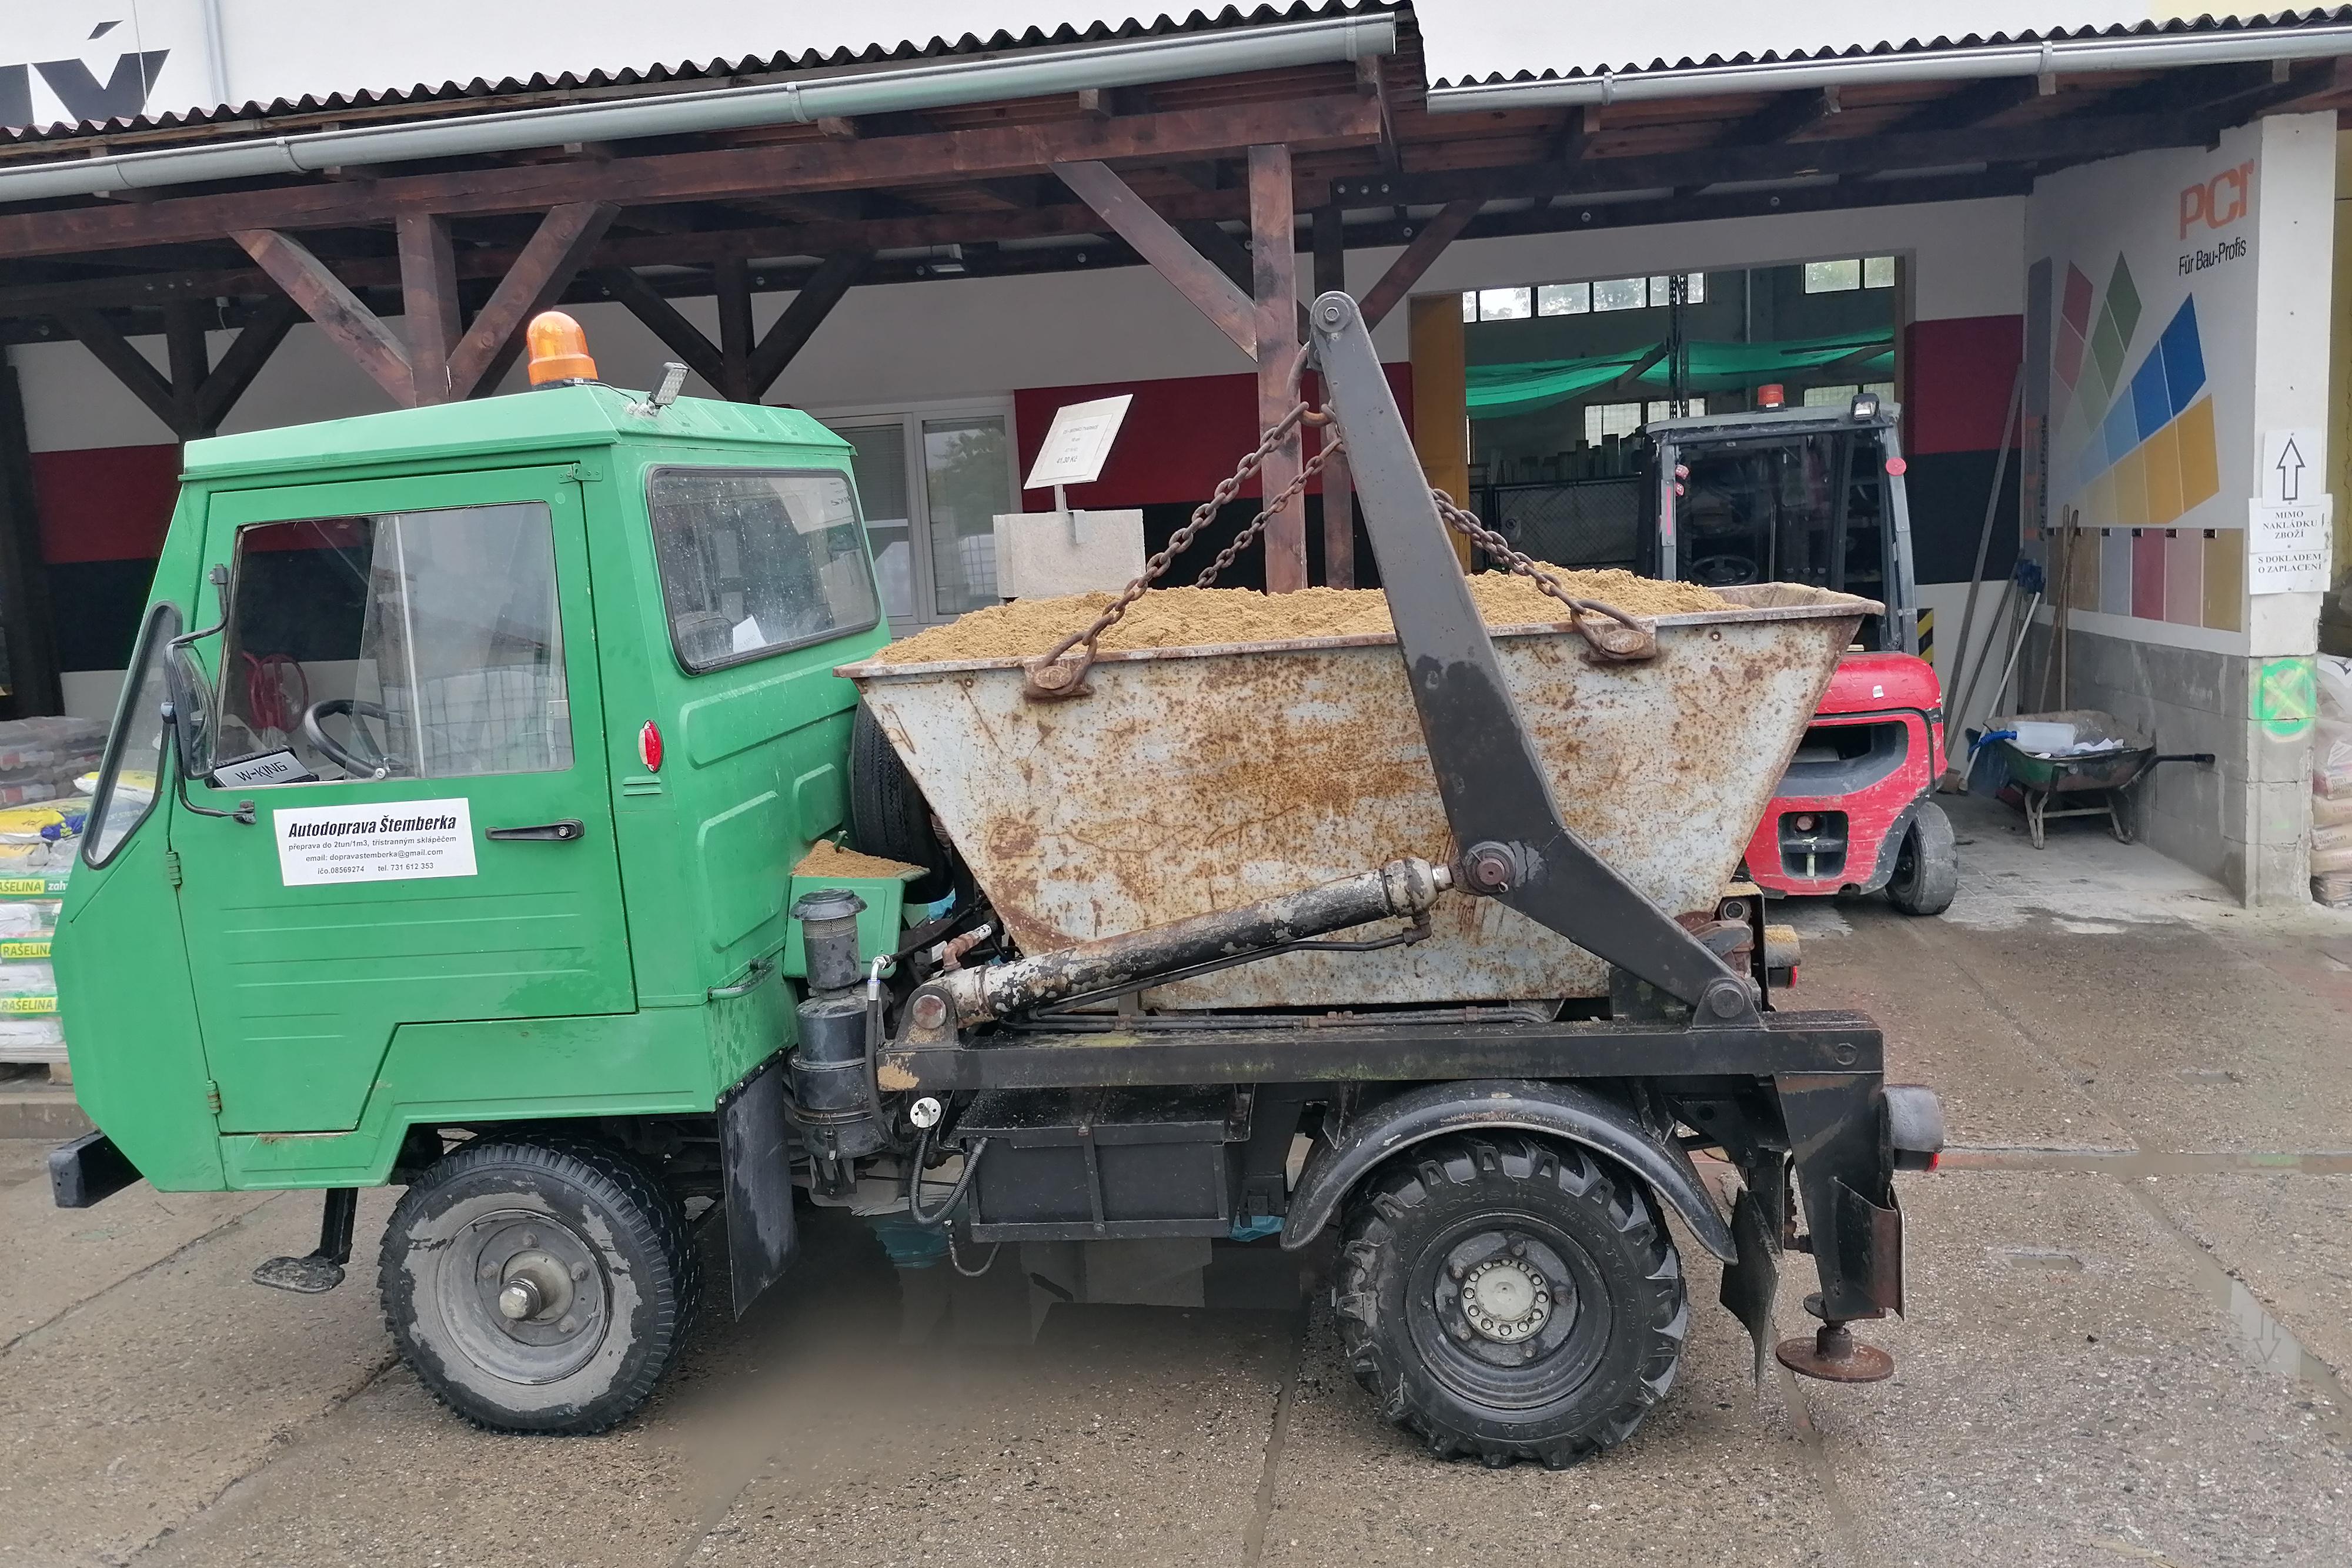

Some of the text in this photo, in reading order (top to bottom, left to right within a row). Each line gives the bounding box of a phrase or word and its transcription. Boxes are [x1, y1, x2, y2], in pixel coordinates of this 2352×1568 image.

[2179, 236, 2246, 276] Für Bau-Profis
[2276, 510, 2304, 519] MIMO
[2263, 519, 2317, 530] NAKLÁDKU
[2275, 529, 2304, 539] ZBOŽÍ
[2266, 553, 2321, 563] DOKLADEM
[2267, 561, 2321, 573] ZAPLACENÍ
[235, 761, 288, 781] W-KING
[288, 815, 456, 838] Autodoprava Štemberka
[289, 843, 320, 851] přeprava
[334, 840, 369, 848] 2tun/1m3,
[372, 837, 415, 846] třístranným
[417, 836, 456, 844] sklápěčem
[329, 849, 443, 861] dopravastemberka@gmail.com
[0, 880, 42, 892] ŠELINA
[2, 998, 54, 1011] RAŠELINA
